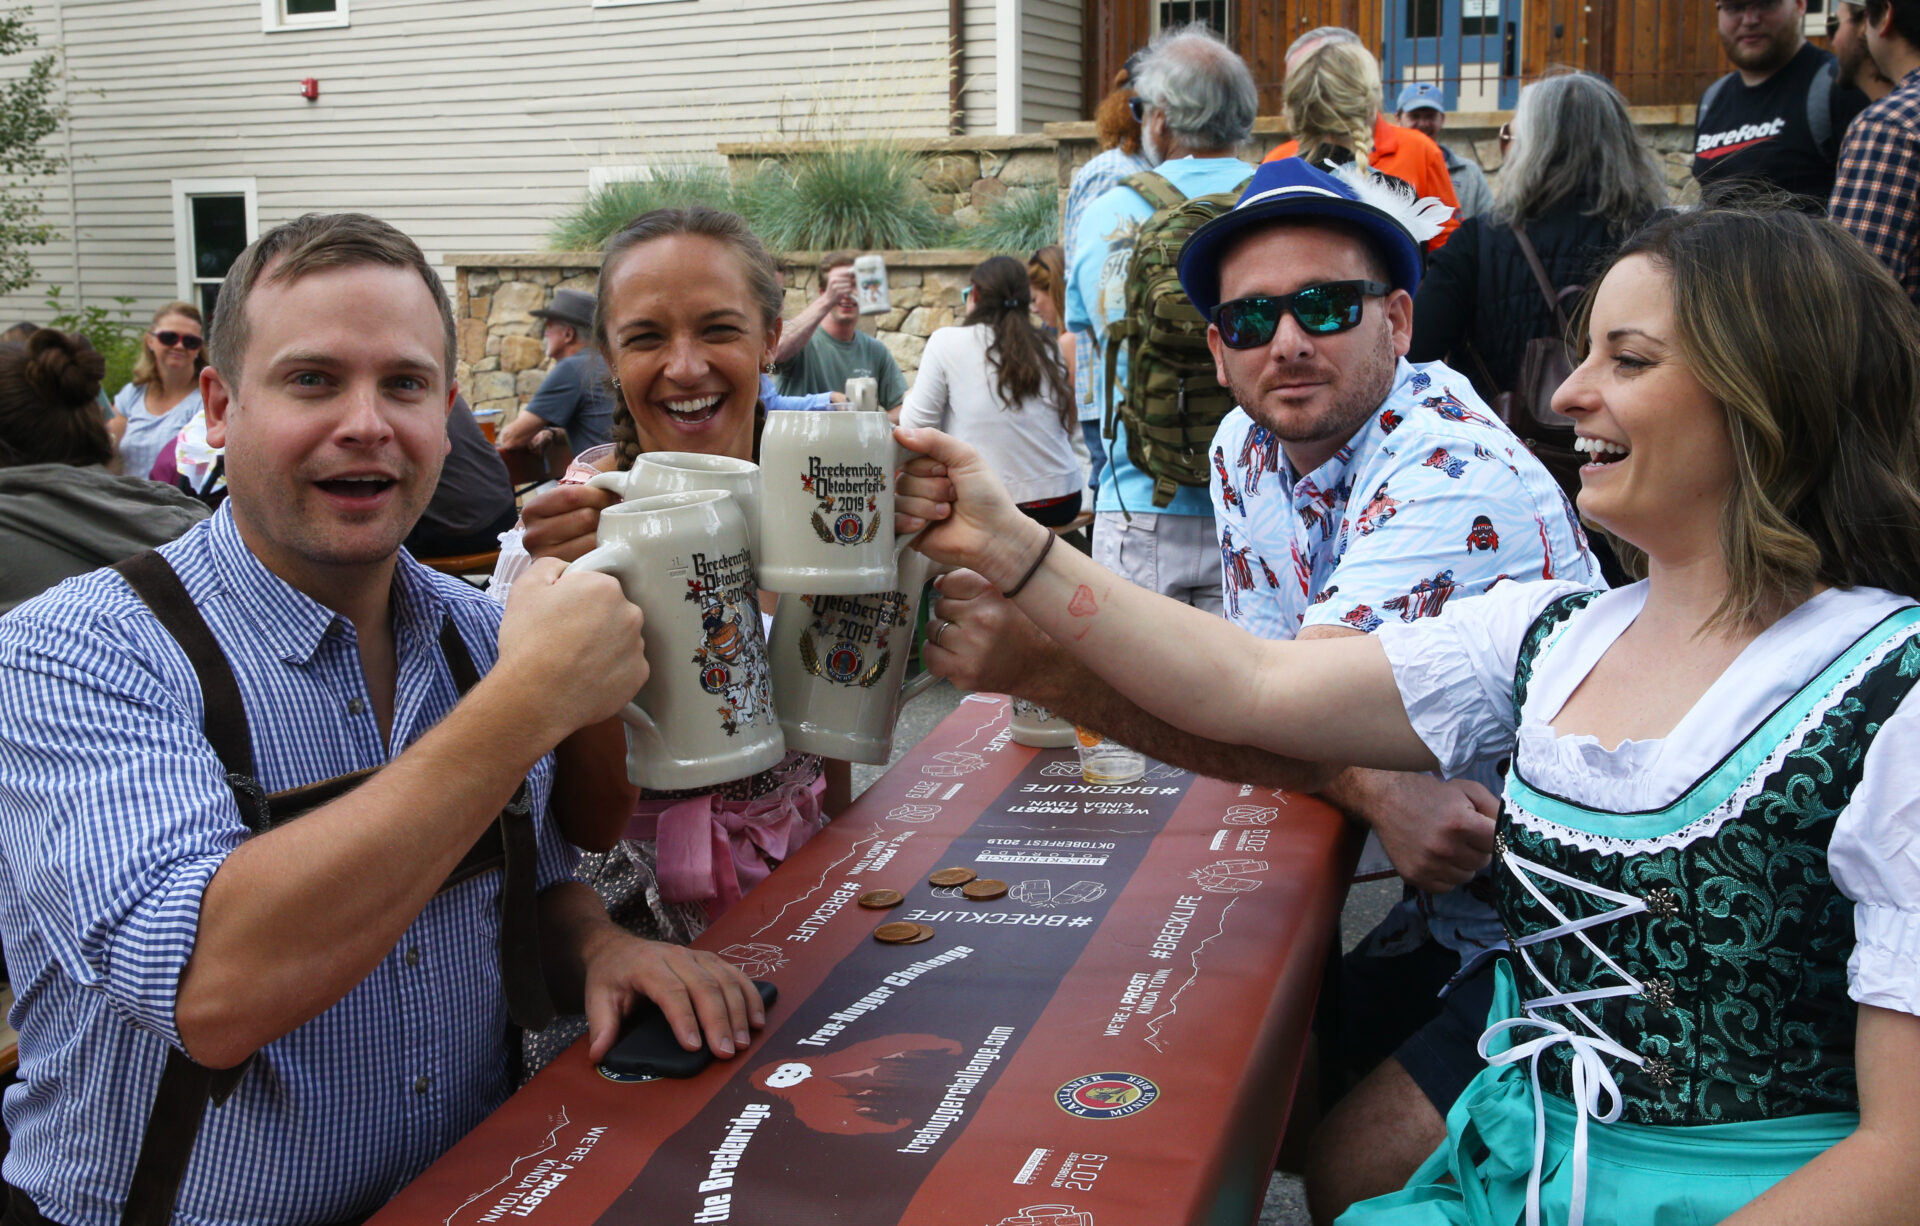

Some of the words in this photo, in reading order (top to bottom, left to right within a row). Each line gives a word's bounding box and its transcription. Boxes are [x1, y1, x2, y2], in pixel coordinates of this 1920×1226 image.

[808, 456, 883, 480] Breckenridge
[815, 477, 881, 500] Oktoberfest
[838, 496, 864, 512] 2019
[837, 619, 873, 644] 2019
[1020, 783, 1181, 796] #BRECKLIFE
[1006, 806, 1079, 815] PROST!
[1029, 800, 1079, 808] TOWN.
[1083, 807, 1095, 815] A
[1085, 801, 1134, 809] KINDA
[1100, 807, 1150, 815] WE'RE
[986, 838, 1021, 846] 2019
[1024, 840, 1116, 850] OKTOBERFEST
[1245, 830, 1271, 851] 2019
[981, 849, 1110, 859] COLORADO
[786, 882, 862, 942] #BRECKLIFE
[903, 909, 1094, 928] #BRECKLIFE
[1148, 895, 1203, 960] #BRECKLIFE
[796, 985, 895, 1046] Tree-Hugger
[882, 944, 975, 988] Challenge
[1103, 1012, 1131, 1037] WE'RE
[1120, 972, 1151, 1005] PROST!
[1136, 990, 1161, 1014] KINDA
[897, 1025, 1016, 1154] treehuggerchallenge.com
[1126, 1075, 1154, 1090] BIER
[1059, 1075, 1104, 1115] PAULANER
[1110, 1092, 1156, 1116] MUNICH
[565, 1126, 608, 1162] WE'RE
[698, 1103, 771, 1193] Breckenridge
[514, 1158, 560, 1189] KINDA
[556, 1162, 575, 1170] A
[1065, 1153, 1108, 1191] 2019
[511, 1172, 568, 1217] PROST!
[477, 1191, 527, 1223] TOWN.
[694, 1192, 732, 1224] the
